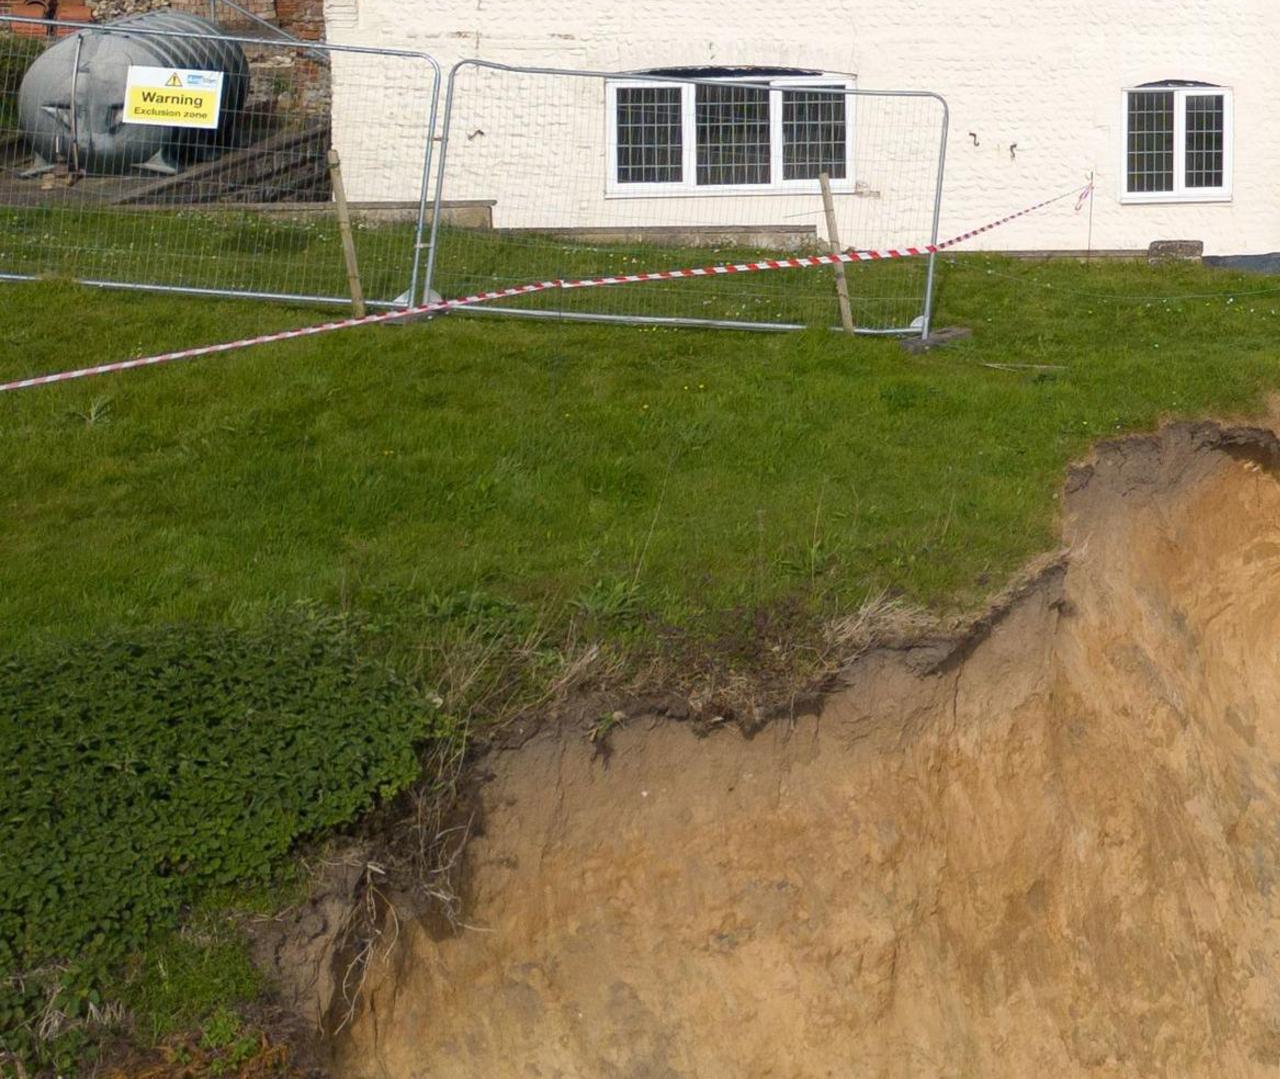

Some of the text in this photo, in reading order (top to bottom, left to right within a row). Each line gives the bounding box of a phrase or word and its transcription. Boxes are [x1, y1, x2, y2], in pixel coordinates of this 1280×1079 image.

[142, 91, 203, 108] Warning
[134, 107, 208, 119] Exclusion zone
